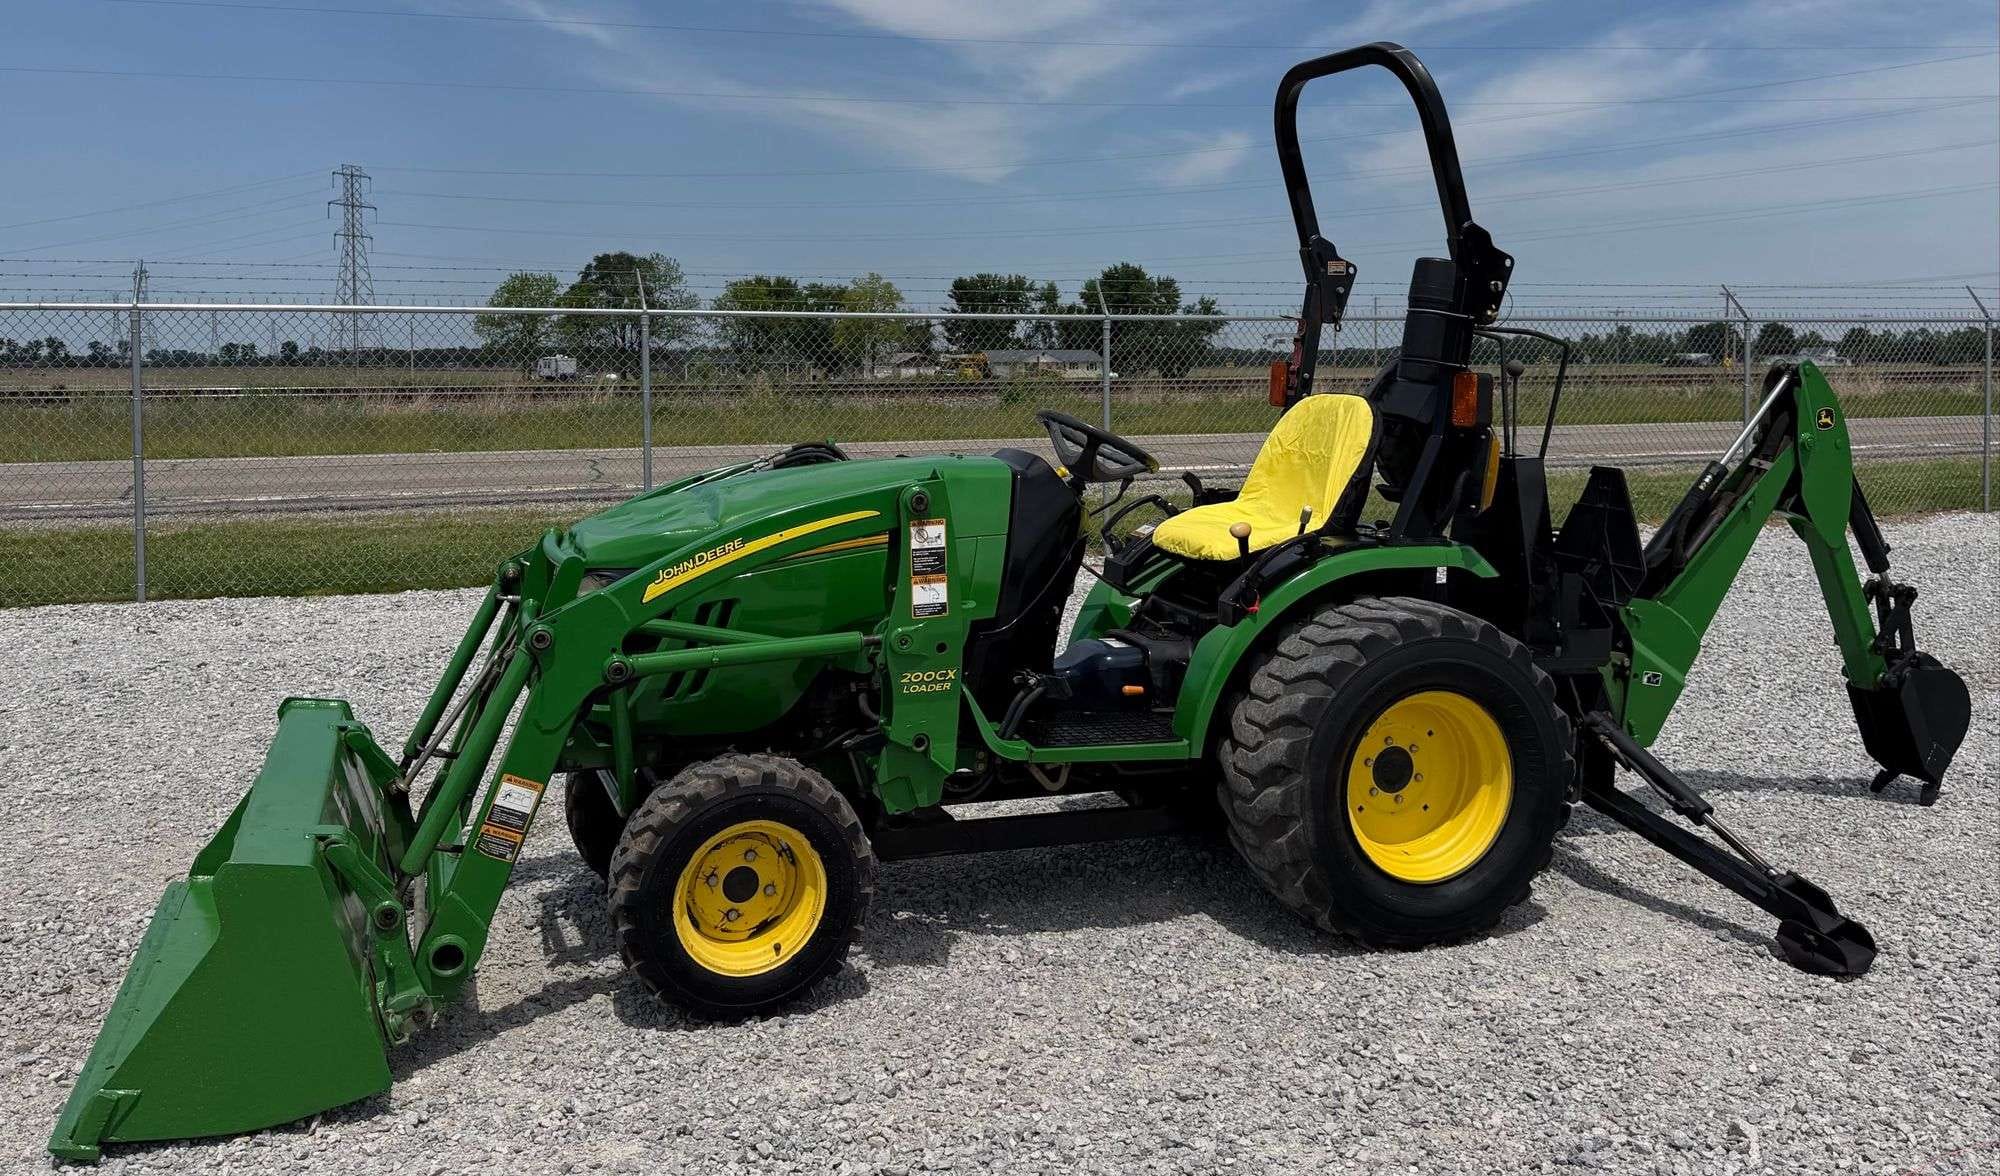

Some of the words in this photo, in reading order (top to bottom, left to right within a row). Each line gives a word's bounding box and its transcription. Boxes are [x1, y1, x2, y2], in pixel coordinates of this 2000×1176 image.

[655, 559, 694, 583] JOHN
[695, 537, 744, 566] DEERE
[901, 669, 957, 682] 200CX
[903, 682, 951, 693] LOADER
[513, 777, 539, 790] WARNING
